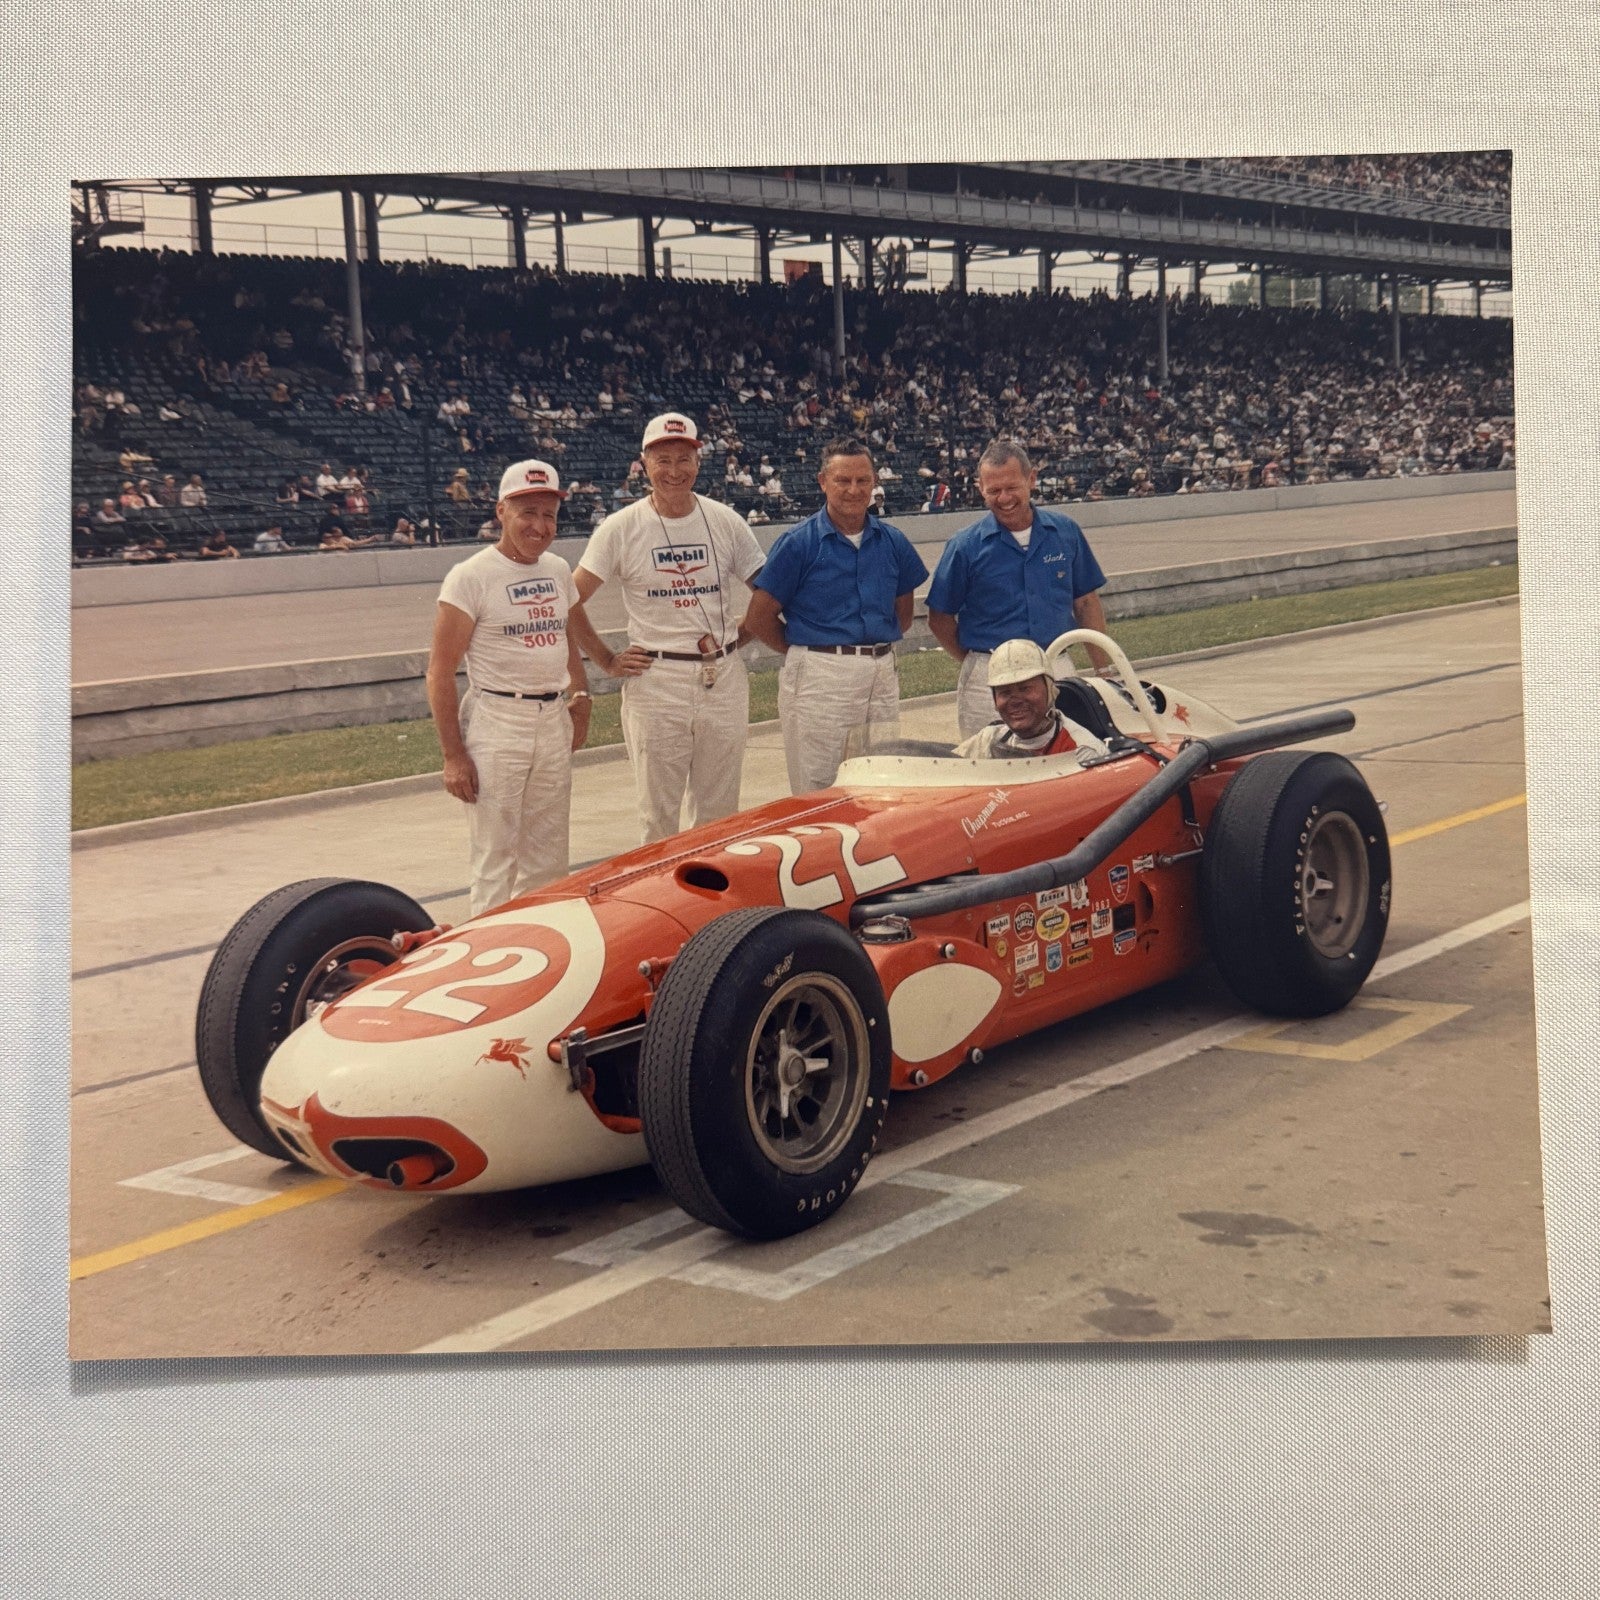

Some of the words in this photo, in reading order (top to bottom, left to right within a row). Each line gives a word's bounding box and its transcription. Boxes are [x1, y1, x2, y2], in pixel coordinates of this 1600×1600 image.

[658, 549, 704, 563] Mobil
[513, 583, 554, 598] Mobil
[671, 579, 696, 588] 1963
[647, 585, 720, 597] INDIANAPOLIS
[528, 606, 555, 619] 1962
[961, 800, 998, 838] Chapman
[724, 822, 909, 910] 22
[990, 918, 1008, 931] Mobil
[333, 941, 549, 1024] 22
